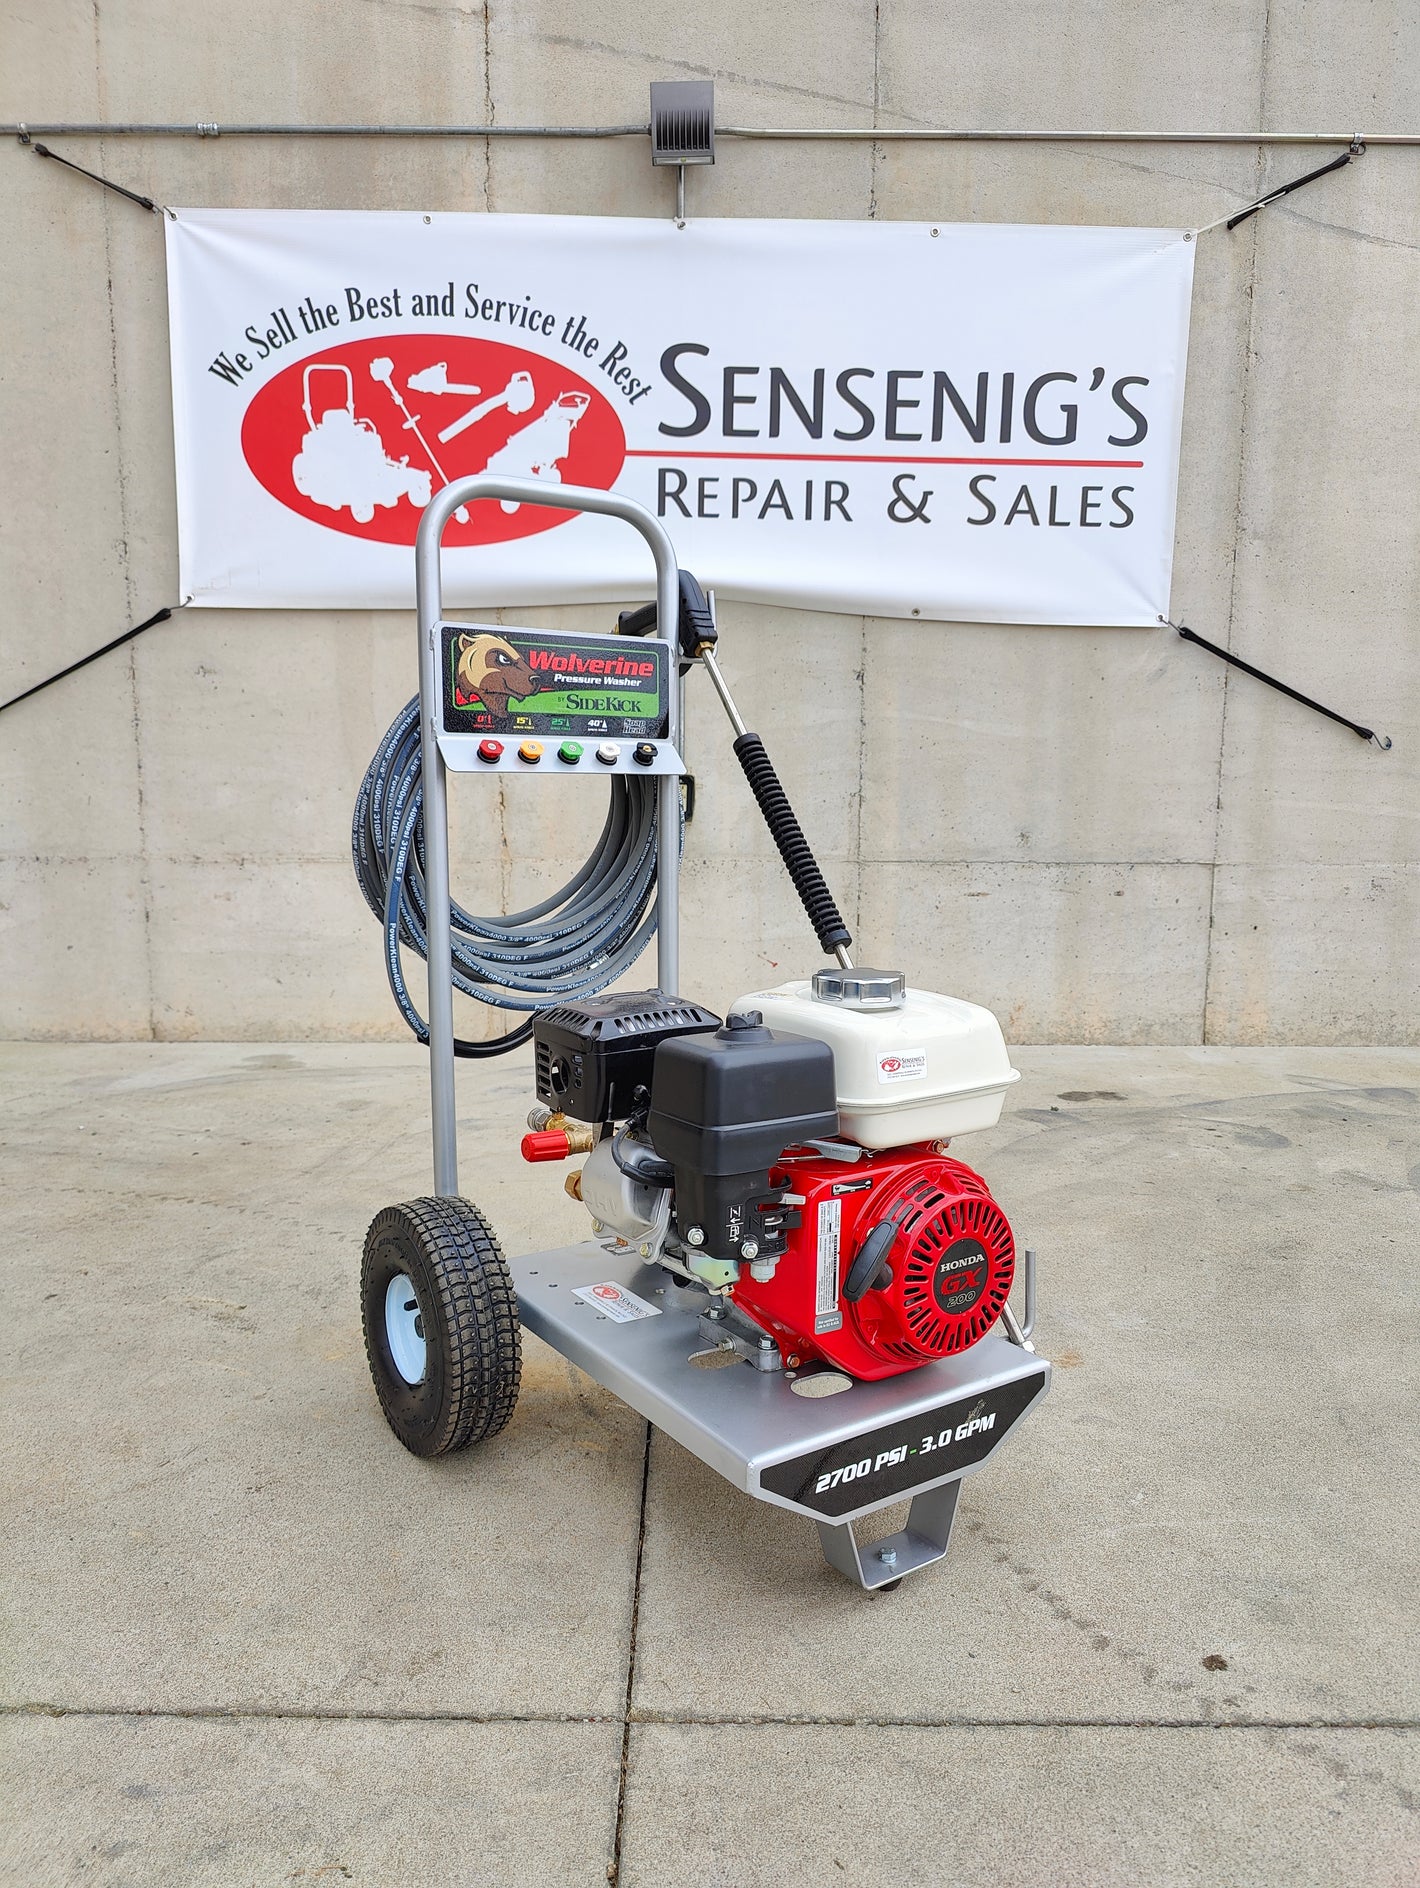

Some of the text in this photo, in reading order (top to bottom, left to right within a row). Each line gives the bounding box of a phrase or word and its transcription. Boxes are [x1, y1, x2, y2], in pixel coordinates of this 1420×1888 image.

[208, 282, 652, 405] We Sell the Best and Service the Rest
[657, 342, 1150, 447] SENSENIG'S
[657, 468, 1135, 528] REPAIR & SALES
[529, 650, 654, 677] Wolverine
[554, 673, 642, 687] Pressure Washer
[623, 726, 646, 734] Head
[624, 718, 646, 727] Soap
[373, 812, 384, 848] 310DEG
[390, 809, 402, 845] 310DEG
[403, 806, 418, 839] 4000psi
[395, 840, 409, 874] 310DEG
[389, 922, 402, 993] PowerKlean4000
[405, 1009, 425, 1034] 4000psi
[940, 1253, 985, 1273] HONDA
[941, 1266, 983, 1295] GX
[947, 1290, 976, 1308] 200
[815, 1458, 872, 1494] 2700
[874, 1444, 908, 1472] PSI
[919, 1428, 953, 1455] 3.0
[954, 1412, 997, 1442] GPM
